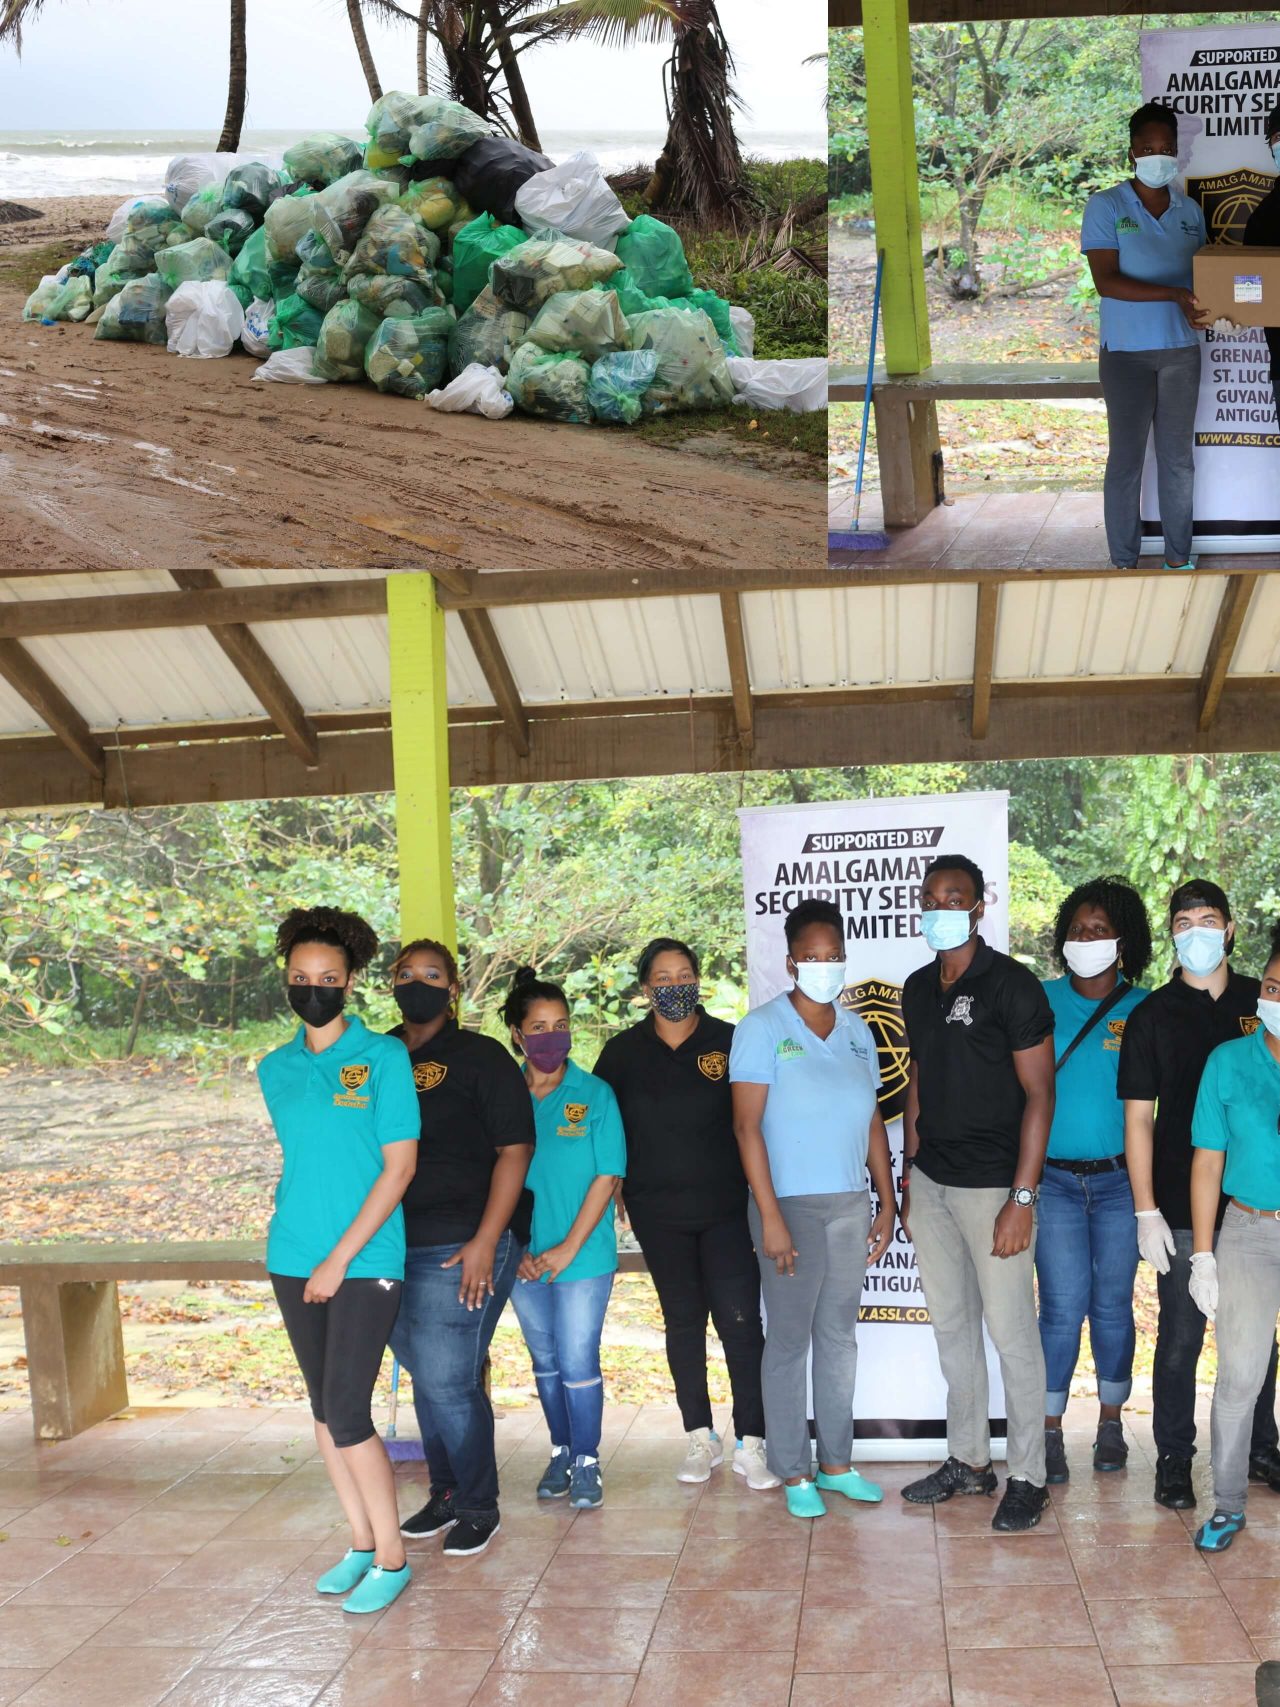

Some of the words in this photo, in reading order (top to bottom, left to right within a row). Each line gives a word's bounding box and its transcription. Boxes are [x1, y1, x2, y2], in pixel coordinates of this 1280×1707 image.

[1198, 48, 1277, 64] SUPPORTED
[1205, 116, 1270, 137] LIMIT
[1198, 171, 1276, 191] AMALGAMAT
[1213, 369, 1234, 383] ST.
[1238, 369, 1272, 385] LUCI
[1199, 434, 1280, 446] WWW.ASSL.CO
[811, 831, 909, 851] SUPPORTED
[912, 829, 935, 846] BY
[774, 856, 934, 887] AMALGAMAT
[848, 914, 922, 940] MITED
